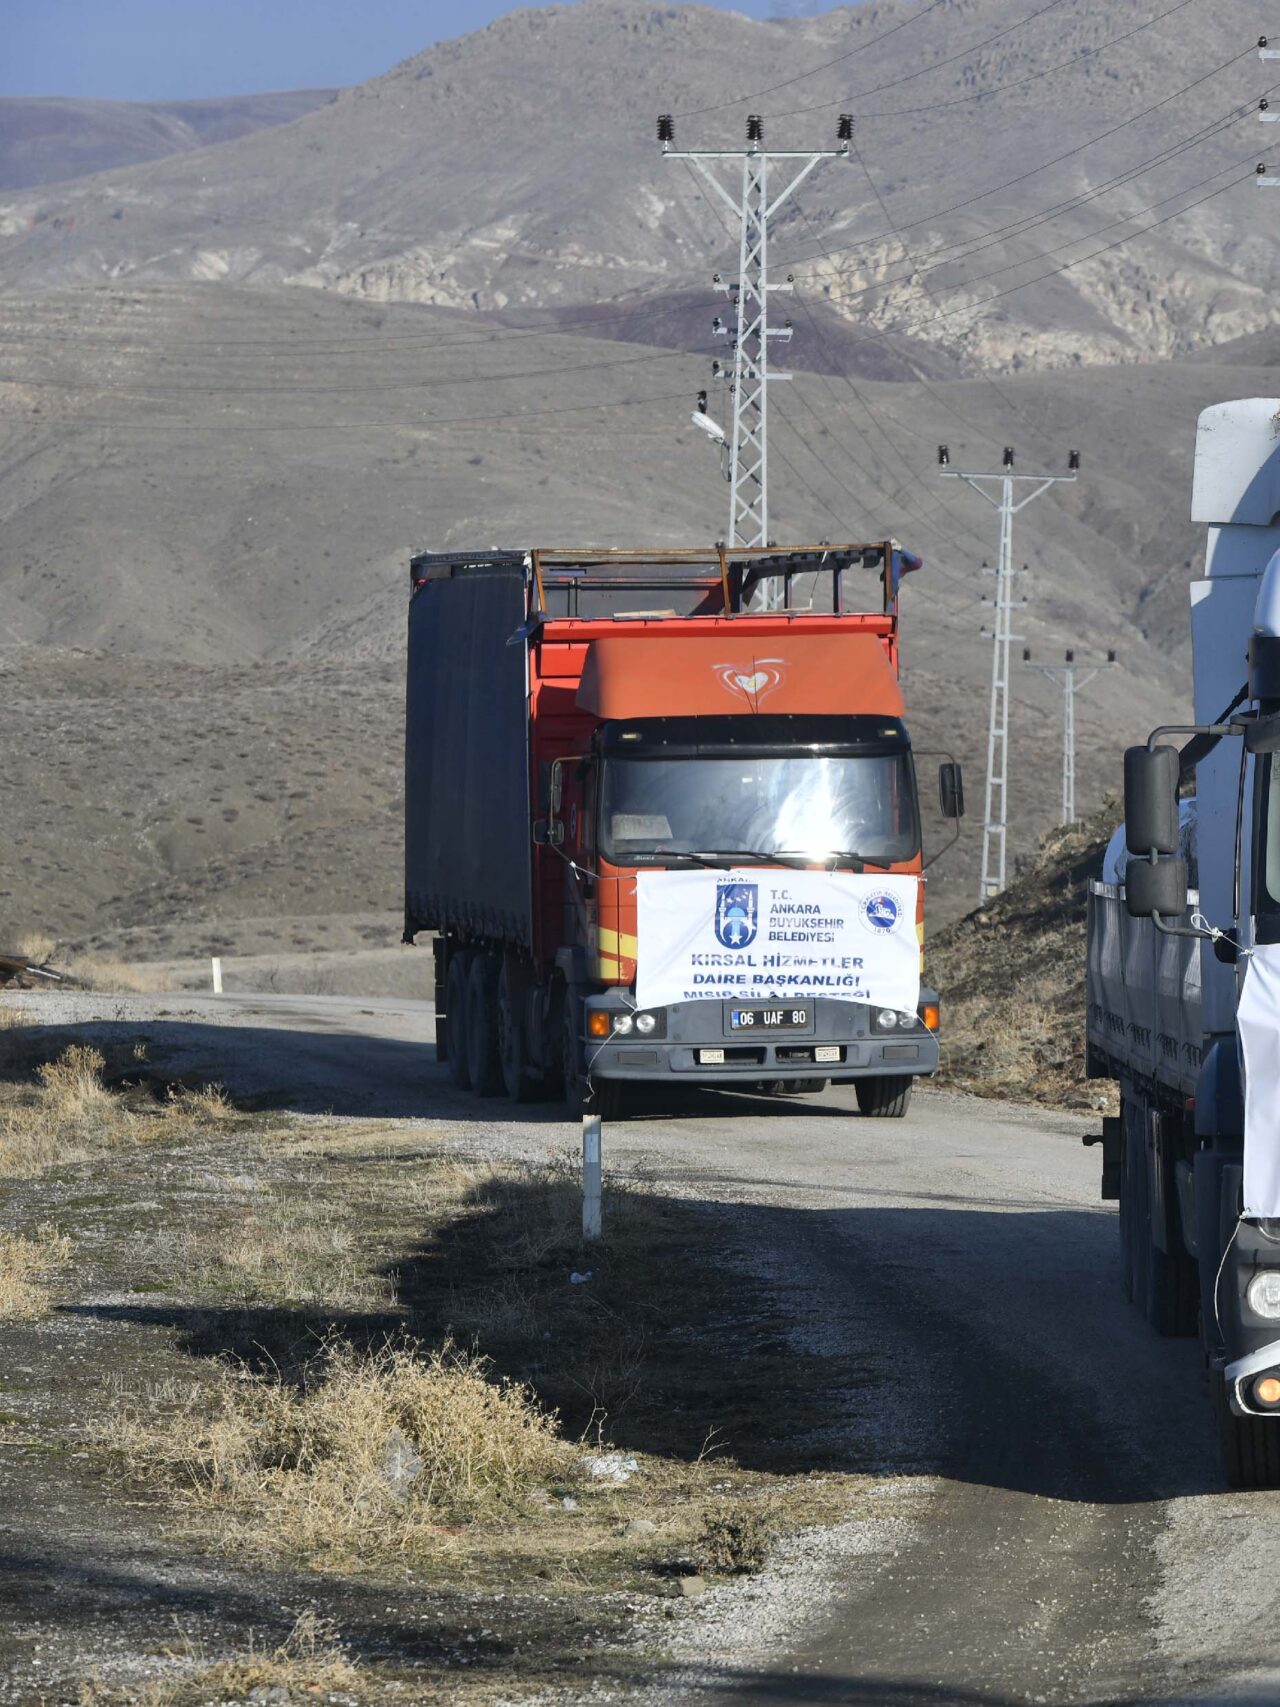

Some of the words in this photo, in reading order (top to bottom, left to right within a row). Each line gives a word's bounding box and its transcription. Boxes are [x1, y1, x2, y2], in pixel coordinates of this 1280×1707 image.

[770, 890, 792, 900] T.C.
[770, 904, 821, 914] ANKARA
[691, 953, 757, 967] KIRSAL
[740, 1012, 754, 1025] 06
[763, 1011, 783, 1024] UAF
[792, 1010, 806, 1024] 80
